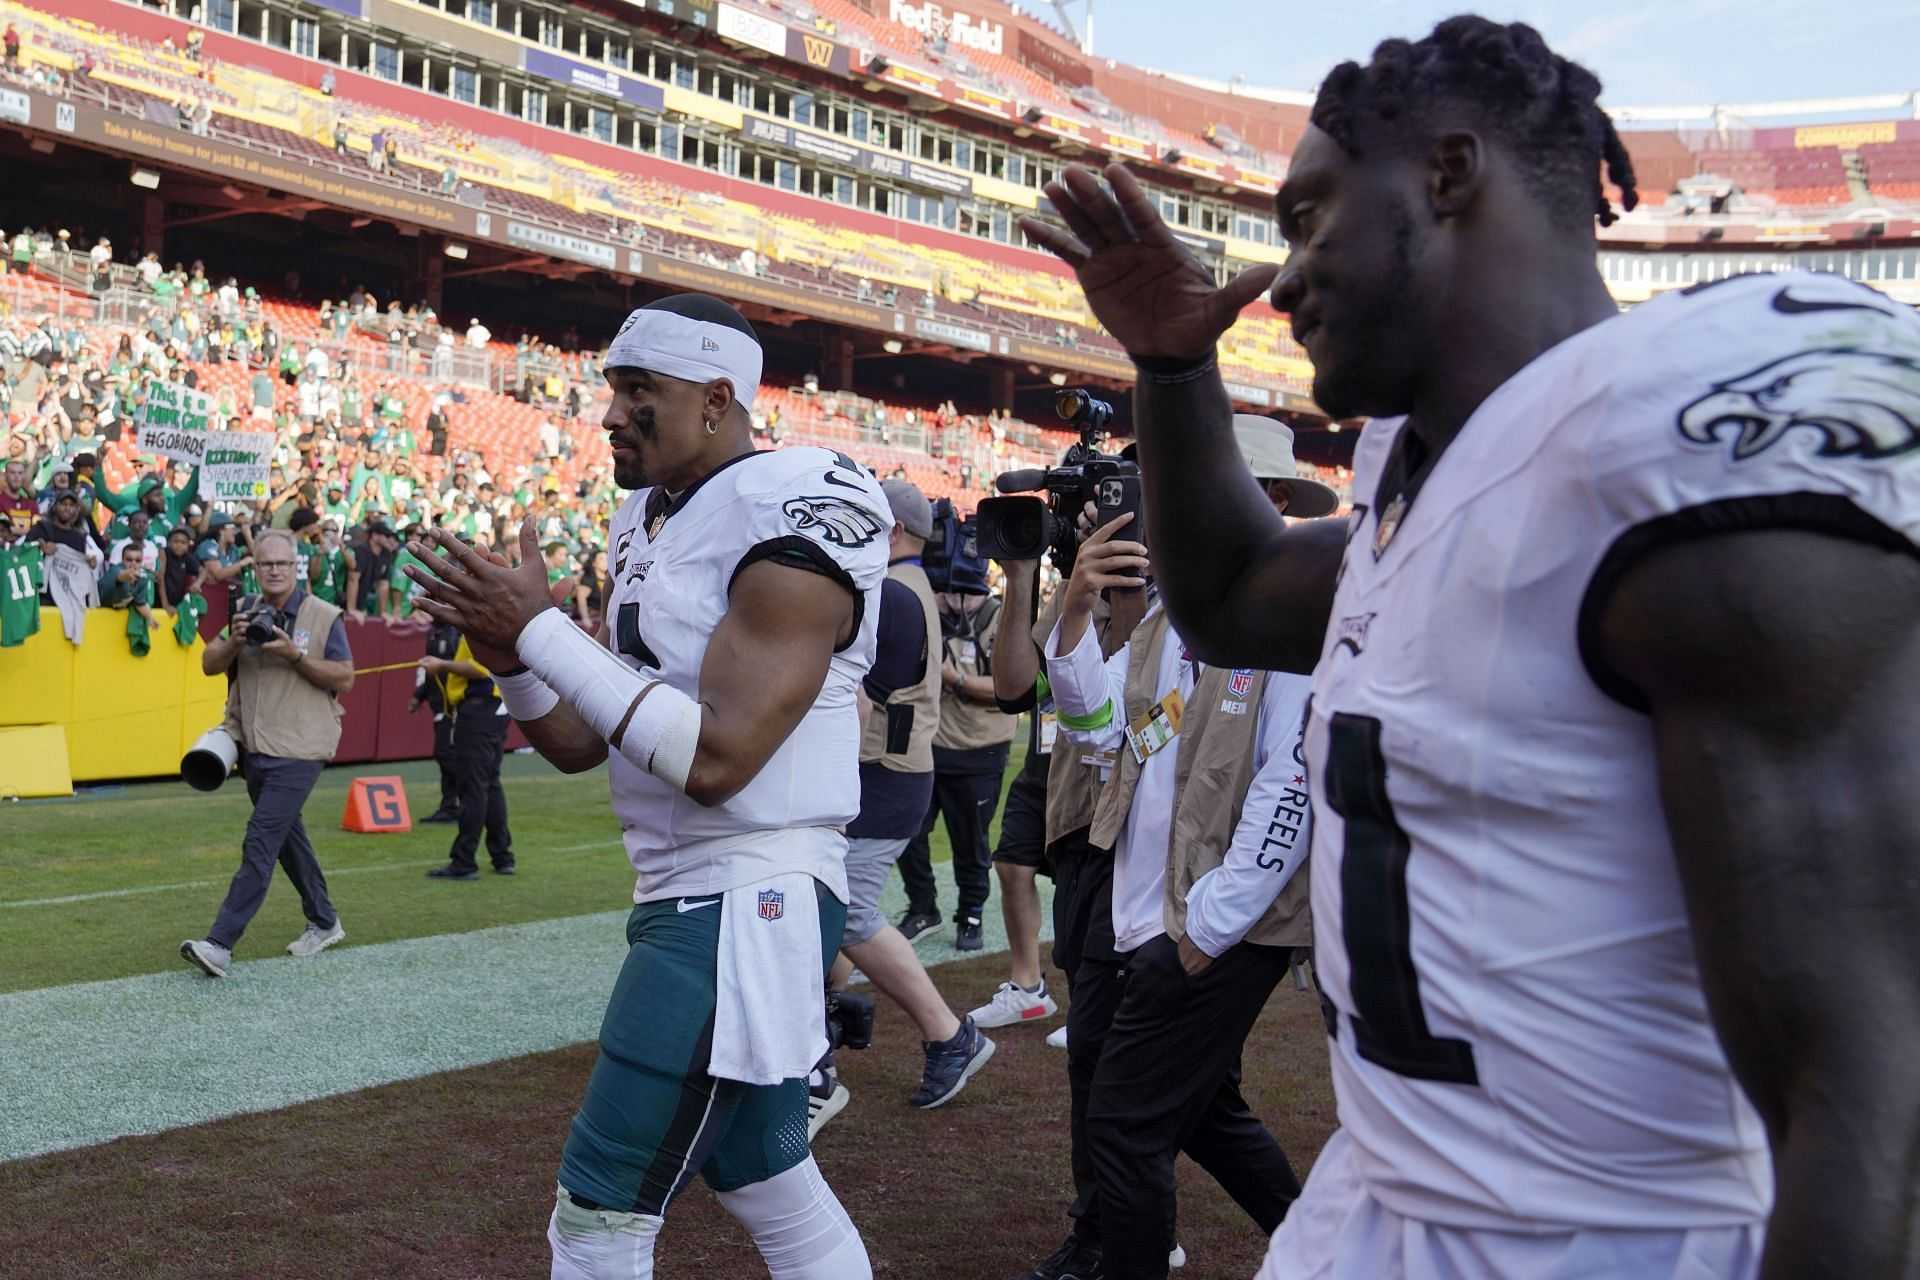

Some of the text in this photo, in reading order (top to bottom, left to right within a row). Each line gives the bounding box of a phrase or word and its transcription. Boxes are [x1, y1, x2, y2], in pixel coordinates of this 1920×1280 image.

[150, 381, 178, 406] This
[183, 389, 192, 409] is
[145, 432, 206, 457] #GOBIRDS
[216, 481, 253, 496] PLEASE
[7, 565, 35, 600] 11
[367, 784, 401, 825] G
[1256, 787, 1308, 873] REELS
[761, 902, 782, 917] NFL
